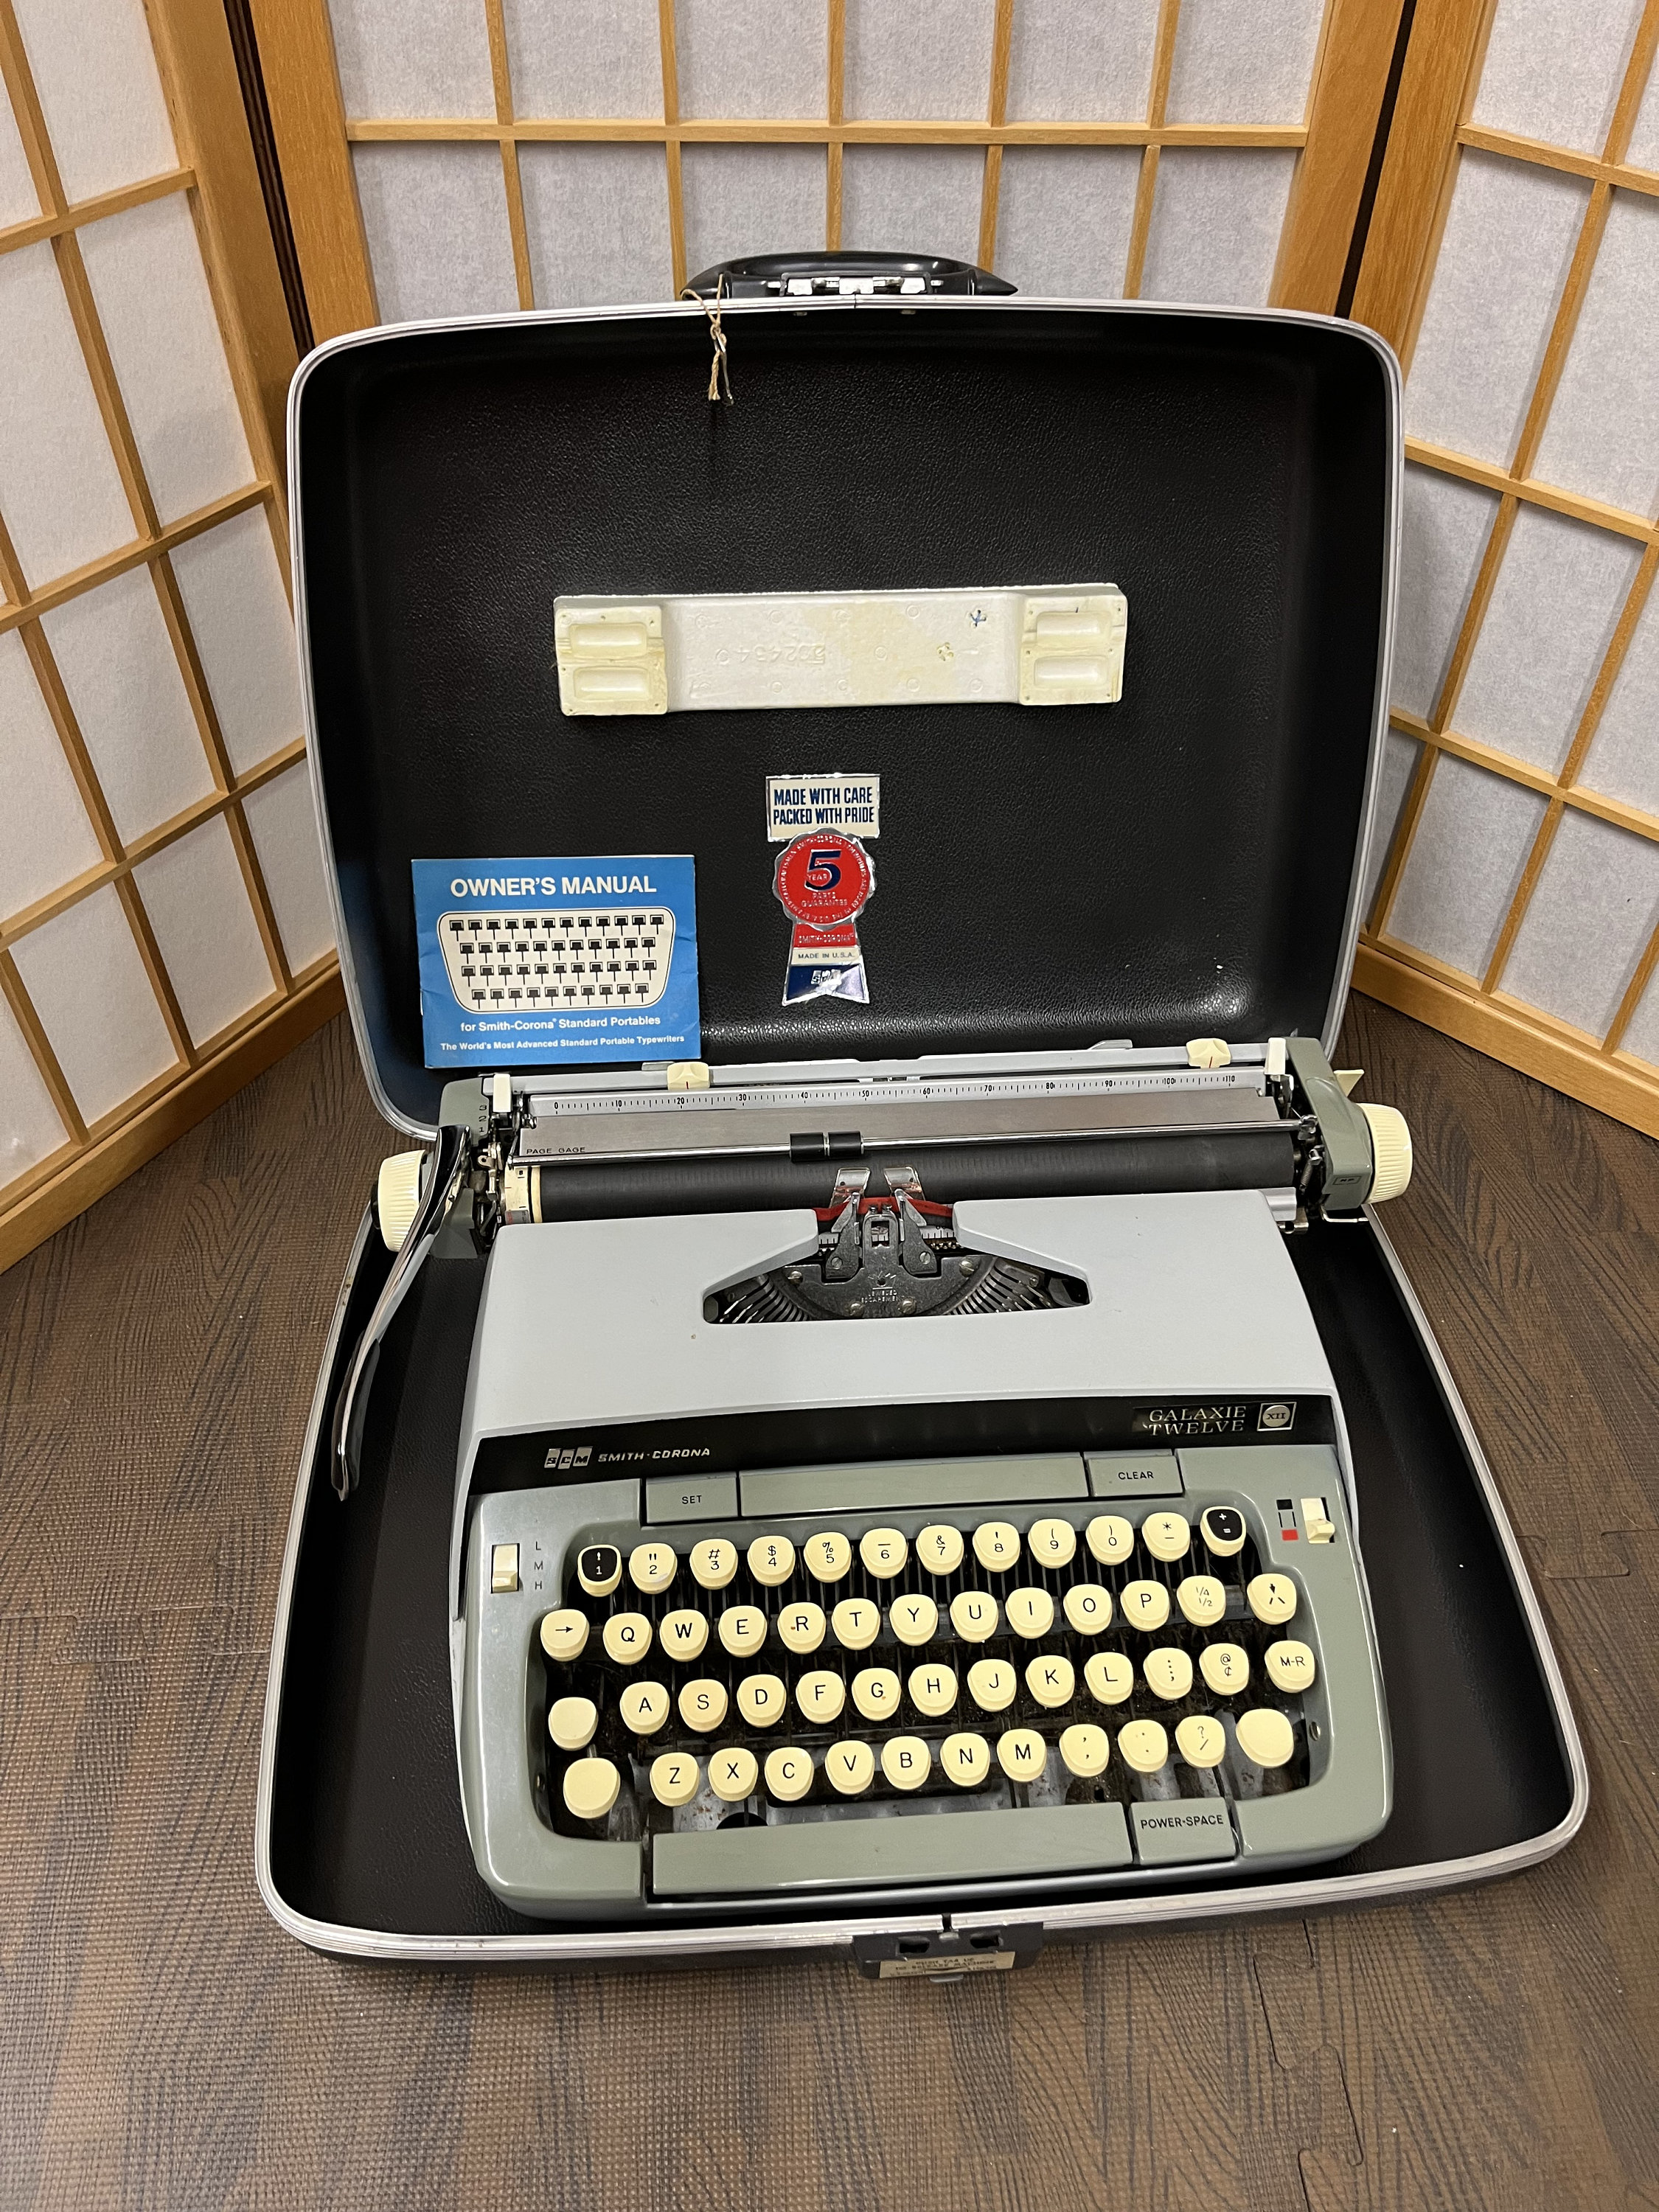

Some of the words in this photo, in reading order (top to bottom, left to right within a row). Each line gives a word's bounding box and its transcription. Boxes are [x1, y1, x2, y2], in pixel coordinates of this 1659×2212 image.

[774, 788, 806, 806] MADE
[810, 787, 840, 804] WITH
[844, 787, 872, 804] CARE
[773, 808, 813, 825] PACKED
[815, 807, 842, 824] WITH
[844, 807, 874, 823] PRIDE
[804, 849, 842, 891] 5
[807, 873, 829, 881] YEAR
[451, 877, 556, 897] OWNER'S
[562, 875, 657, 895] MANUAL
[460, 1022, 476, 1032] for
[558, 1017, 608, 1029] Standard
[611, 1015, 661, 1026] Portables
[441, 1043, 457, 1051] The
[459, 1042, 492, 1050] World's
[493, 1041, 515, 1049] Most
[517, 1040, 558, 1048] Advanced
[560, 1037, 598, 1047] Standard
[600, 1036, 635, 1046] Portable
[636, 1034, 685, 1046] Typewriters
[1149, 1406, 1246, 1422] GALAXIE
[1265, 1412, 1286, 1420] XII
[1148, 1420, 1244, 1436] TWELVE
[1119, 1471, 1153, 1480] CLEAR
[681, 1495, 702, 1504] SET
[536, 1542, 540, 1550] L
[995, 1543, 1004, 1552] 8
[1050, 1540, 1058, 1549] 9
[881, 1550, 889, 1559] 6
[938, 1547, 945, 1555] 7
[768, 1557, 776, 1566] 4
[827, 1554, 834, 1563] 5
[535, 1561, 543, 1570] M
[597, 1566, 602, 1574] 1
[650, 1565, 657, 1574] 2
[711, 1561, 719, 1570] 3
[535, 1581, 542, 1590] H
[621, 1627, 635, 1642] Q
[675, 1623, 692, 1638] W
[737, 1619, 749, 1634] E
[796, 1616, 809, 1631] R
[849, 1612, 861, 1627] T
[908, 1608, 919, 1622] Y
[969, 1604, 981, 1619] U
[1029, 1601, 1032, 1615] I
[1083, 1598, 1096, 1613] O
[1141, 1594, 1151, 1607] P
[639, 1697, 652, 1712] A
[698, 1694, 709, 1709] S
[755, 1689, 768, 1705] D
[815, 1685, 826, 1700] F
[872, 1683, 883, 1697] G
[928, 1678, 940, 1693] H
[990, 1674, 998, 1688] J
[1046, 1669, 1059, 1684] K
[1105, 1667, 1118, 1681] L
[669, 1767, 680, 1784] Z
[727, 1763, 739, 1779] X
[783, 1763, 794, 1778] C
[844, 1756, 856, 1771] V
[900, 1753, 912, 1768] B
[960, 1748, 973, 1764] N
[1015, 1744, 1031, 1759] M
